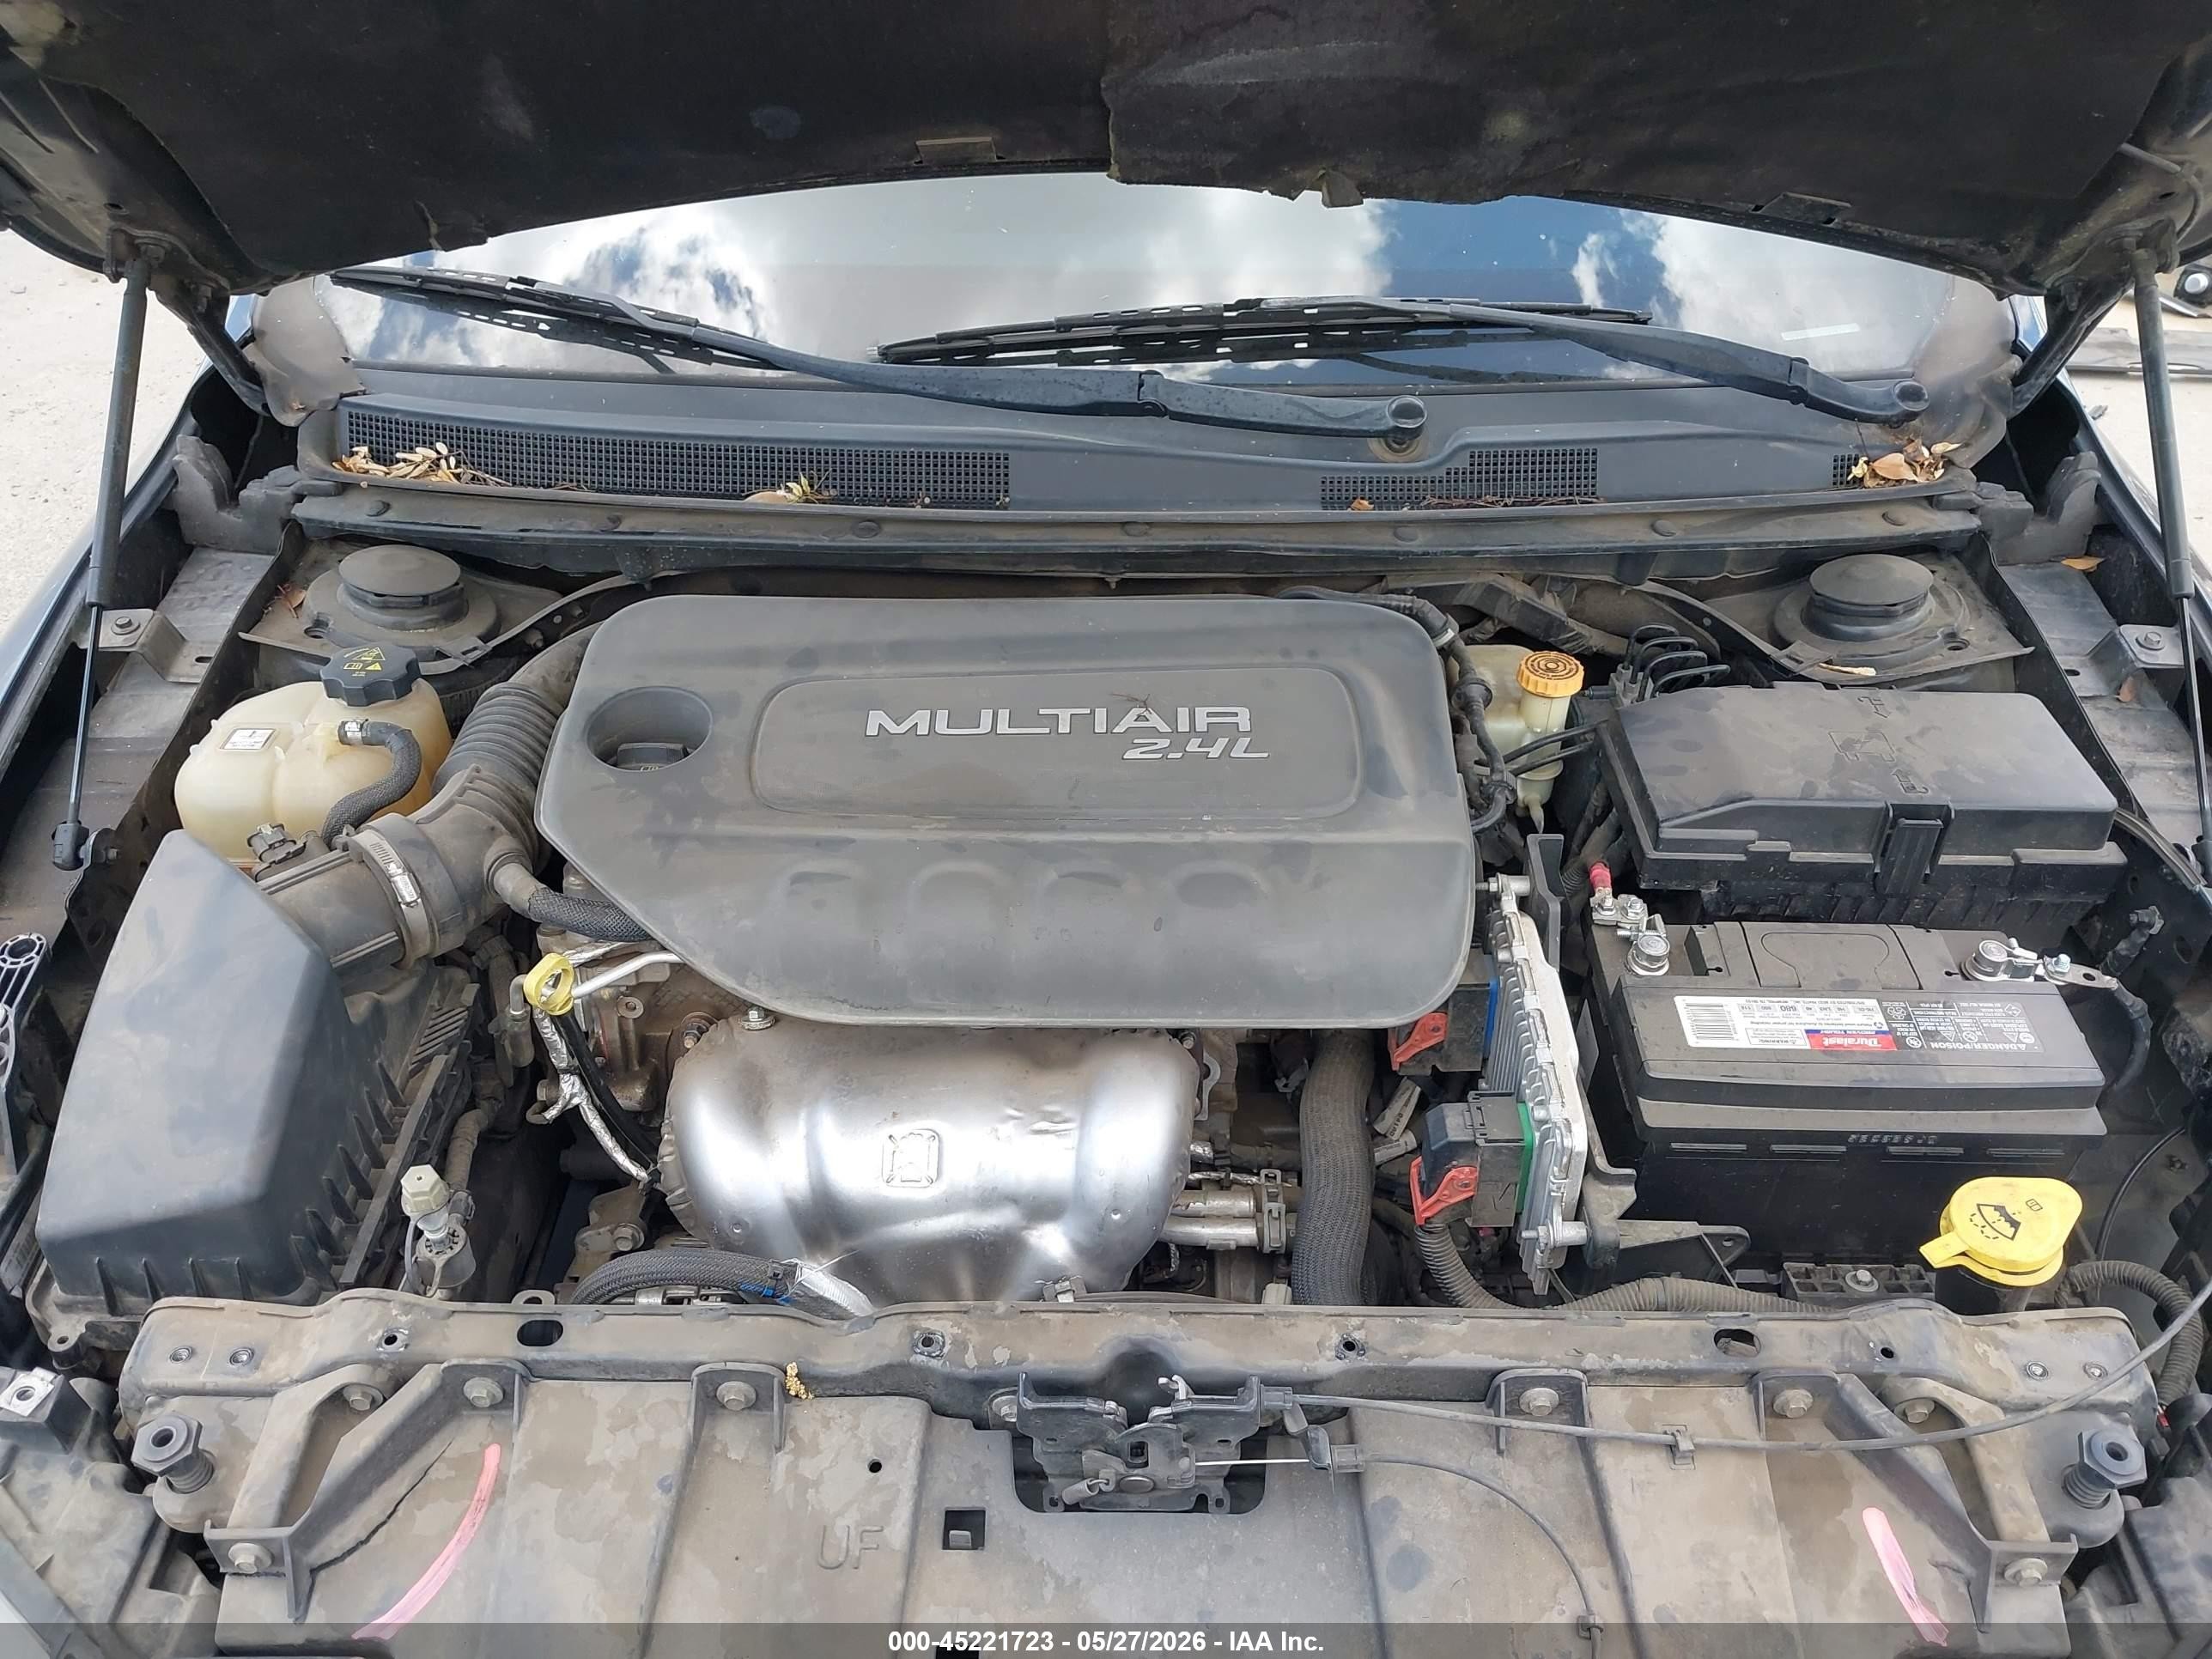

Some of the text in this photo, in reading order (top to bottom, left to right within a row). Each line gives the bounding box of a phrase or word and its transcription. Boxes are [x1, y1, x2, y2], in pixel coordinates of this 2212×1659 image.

[865, 706, 1252, 737] MULTIAIR
[1121, 737, 1271, 760] 2.4L
[1822, 1036, 1882, 1047] Duralast
[1930, 1042, 2018, 1050] DANGER/POISON
[817, 1525, 884, 1570] UF
